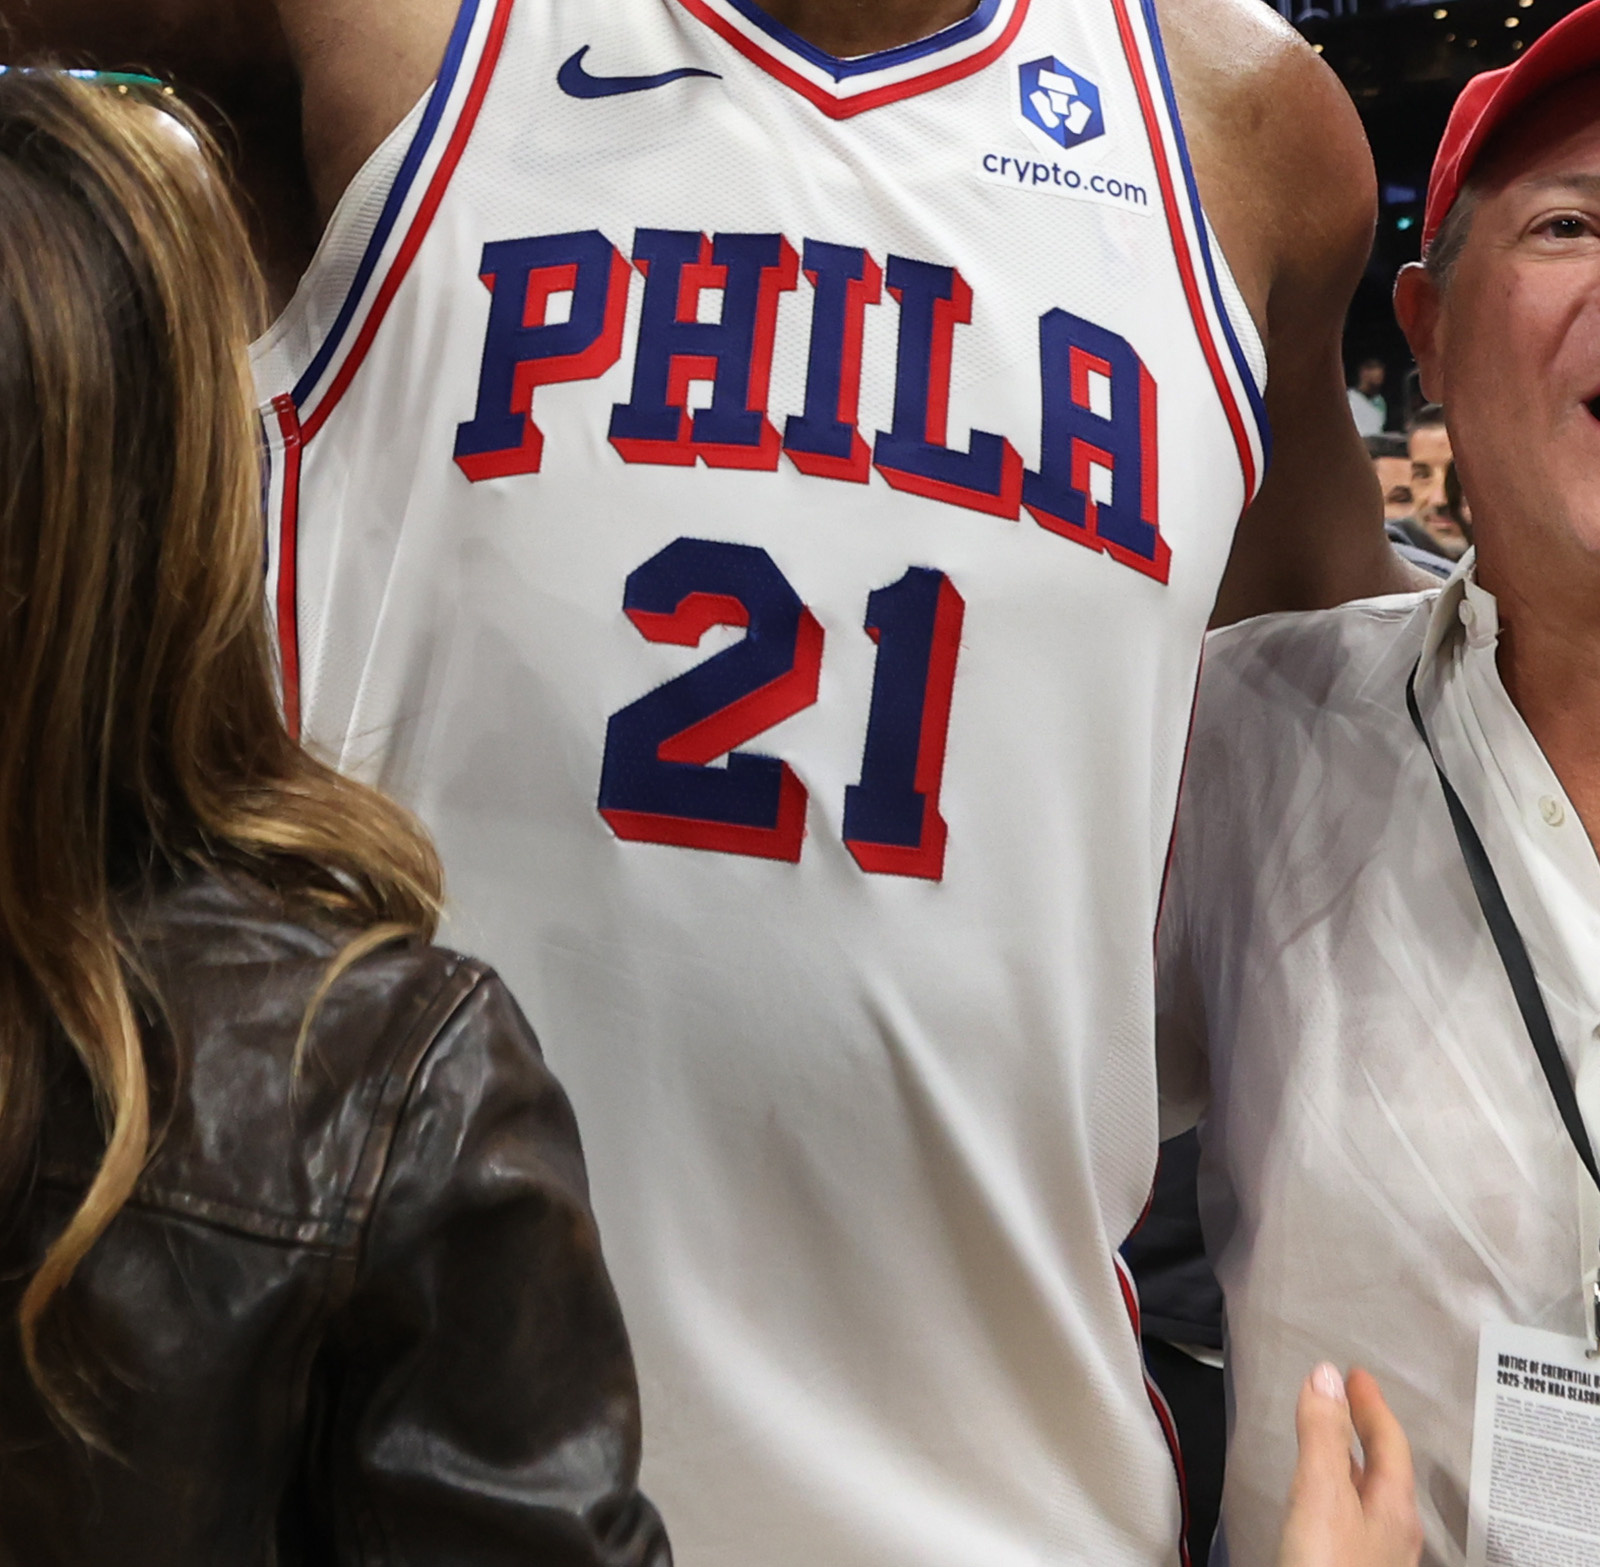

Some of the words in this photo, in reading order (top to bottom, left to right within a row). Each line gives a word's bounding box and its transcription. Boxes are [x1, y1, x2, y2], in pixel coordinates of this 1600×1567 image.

[982, 153, 1148, 206] crypto.com
[453, 228, 1172, 584] PHILA
[598, 536, 965, 882] 21
[1497, 1370, 1546, 1393] 2025-2026
[1547, 1382, 1566, 1398] NBA
[1498, 1353, 1527, 1372] NOTICE
[1529, 1360, 1540, 1373] OF
[1541, 1363, 1592, 1386] CREDENTIAL
